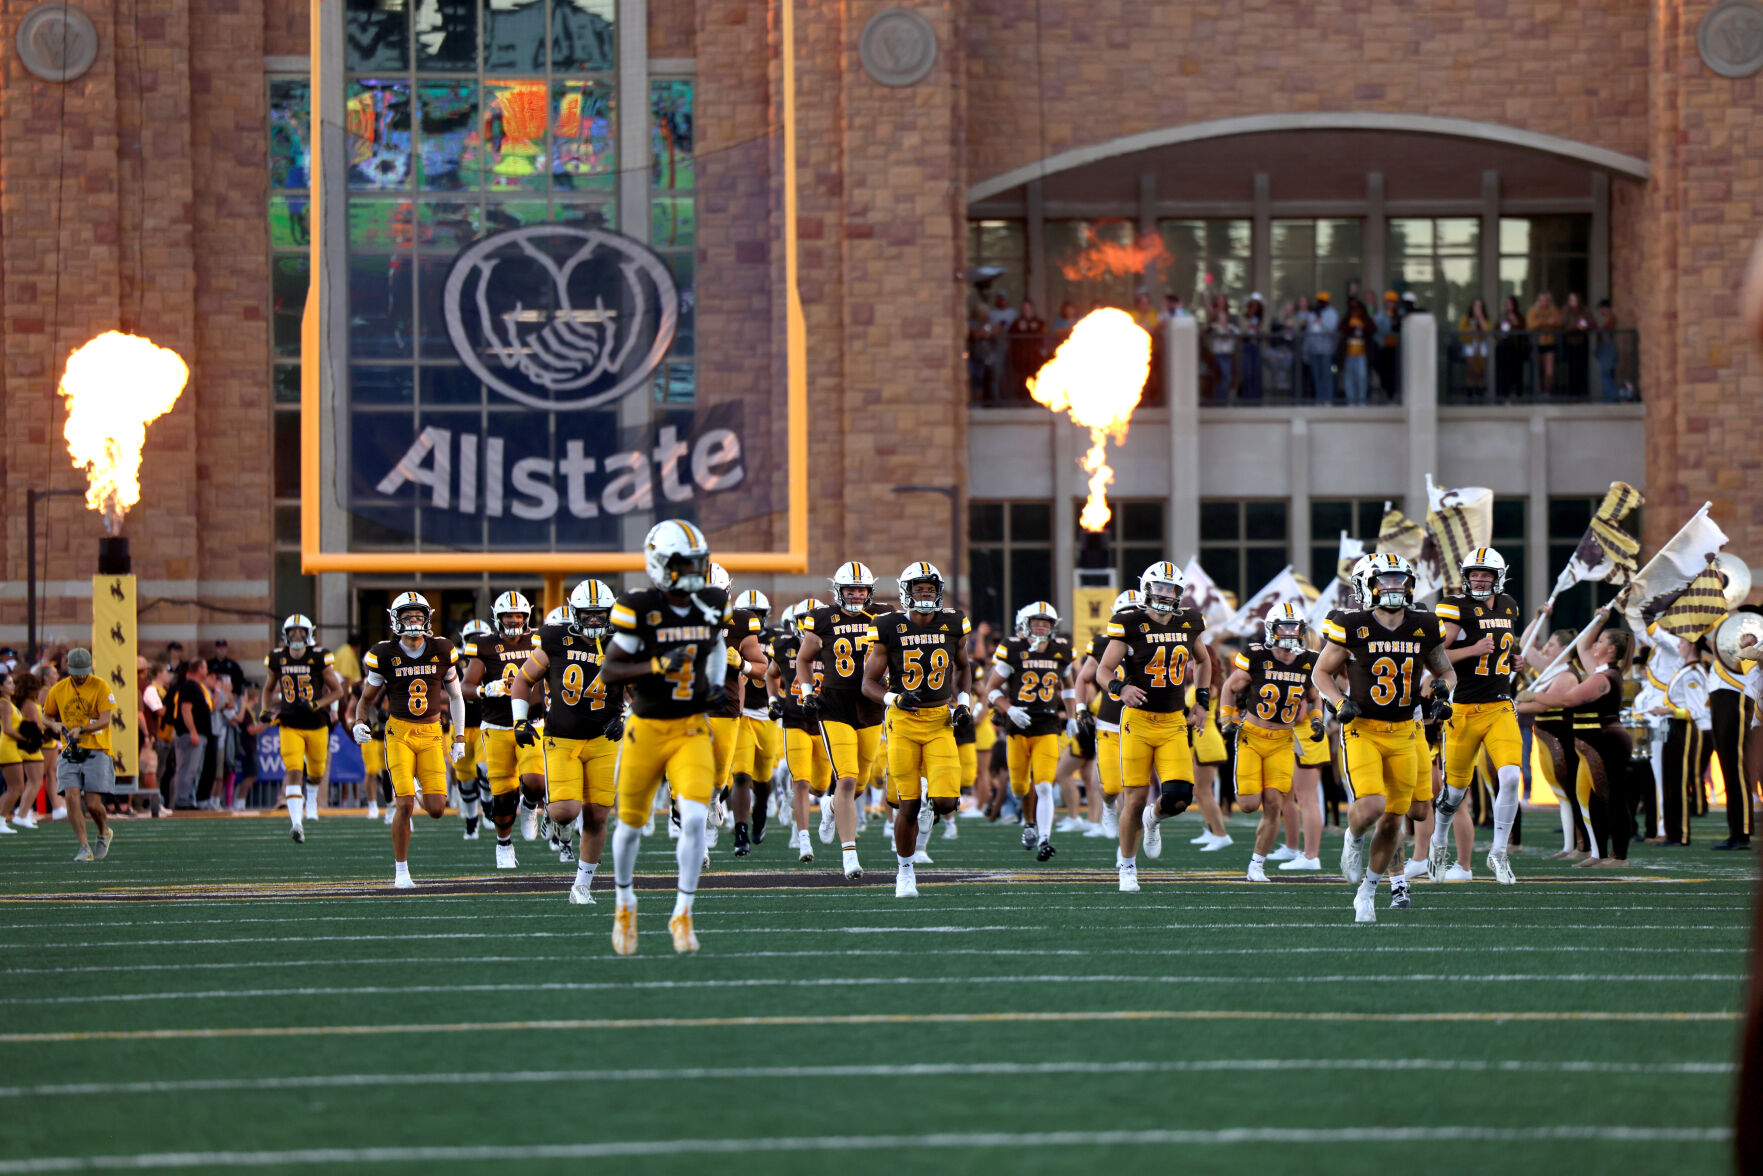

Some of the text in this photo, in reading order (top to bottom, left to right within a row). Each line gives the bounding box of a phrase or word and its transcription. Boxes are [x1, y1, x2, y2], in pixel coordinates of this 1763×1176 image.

[376, 425, 744, 520] Allstate
[833, 623, 869, 636] WYOMIN
[900, 633, 945, 646] WYOMING
[1368, 641, 1421, 654] WYOMING
[394, 665, 437, 677] WYOMING
[499, 650, 533, 661] WYOMIN
[833, 635, 875, 678] 87
[901, 647, 949, 690] 58
[1144, 644, 1189, 688] 40
[1475, 632, 1513, 676] 12
[281, 674, 314, 703] 85
[408, 678, 428, 717] 8
[561, 663, 608, 711] 94
[1018, 671, 1058, 703] 23
[1370, 656, 1414, 707] 31
[1256, 683, 1305, 724] 35
